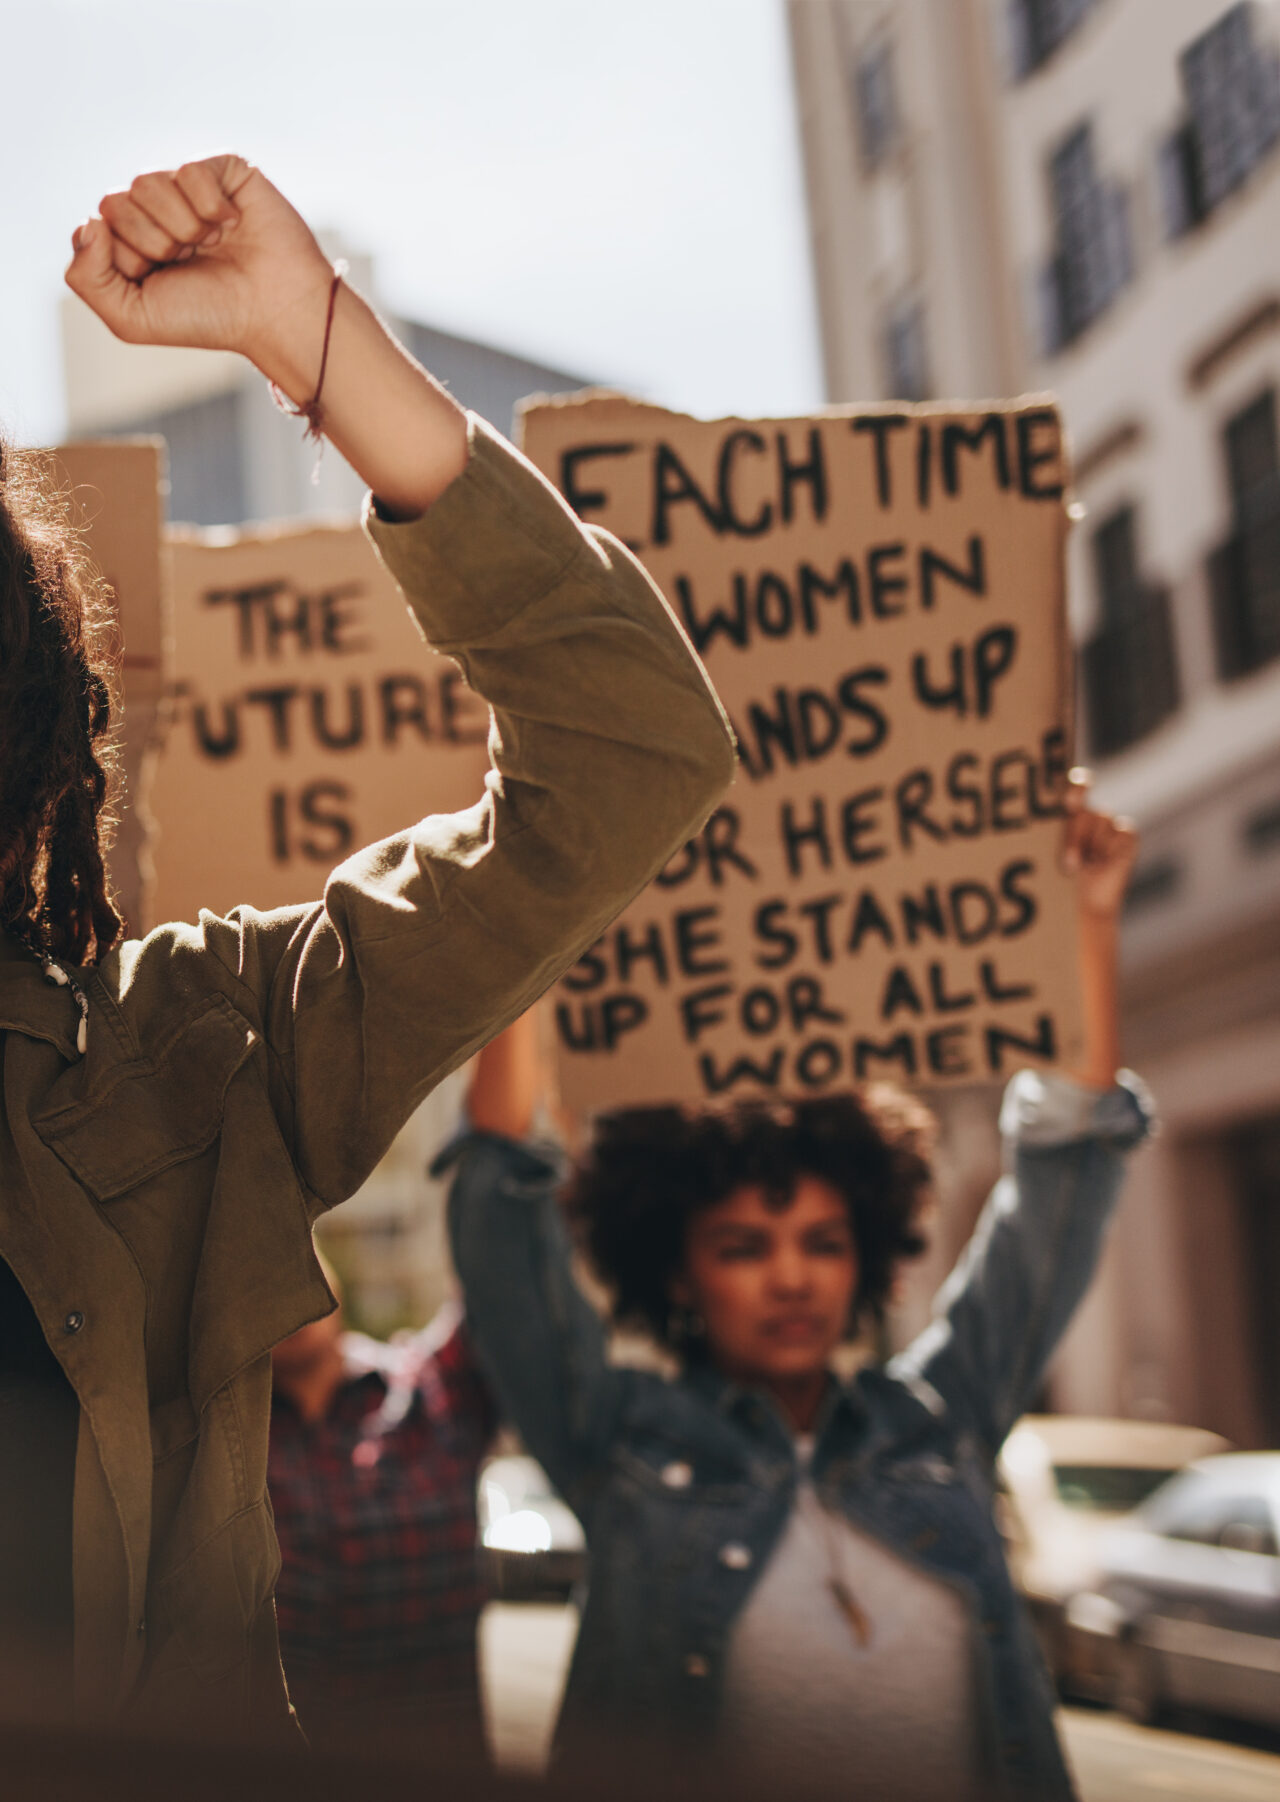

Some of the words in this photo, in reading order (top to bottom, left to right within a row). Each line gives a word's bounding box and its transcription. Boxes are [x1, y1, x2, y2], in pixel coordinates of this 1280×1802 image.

[559, 427, 828, 554] EACH
[850, 413, 1066, 508] TIME
[201, 578, 372, 664] THE
[677, 536, 987, 652] WOMEN
[736, 665, 890, 781] NDS
[911, 624, 1018, 719] UP
[268, 779, 358, 869] IS
[563, 906, 728, 998] SHE
[753, 859, 1038, 971] STANDS
[556, 990, 648, 1054] UP
[678, 975, 844, 1044] FOR
[881, 959, 1033, 1021] ALL
[697, 1013, 1058, 1103] WOMEN
